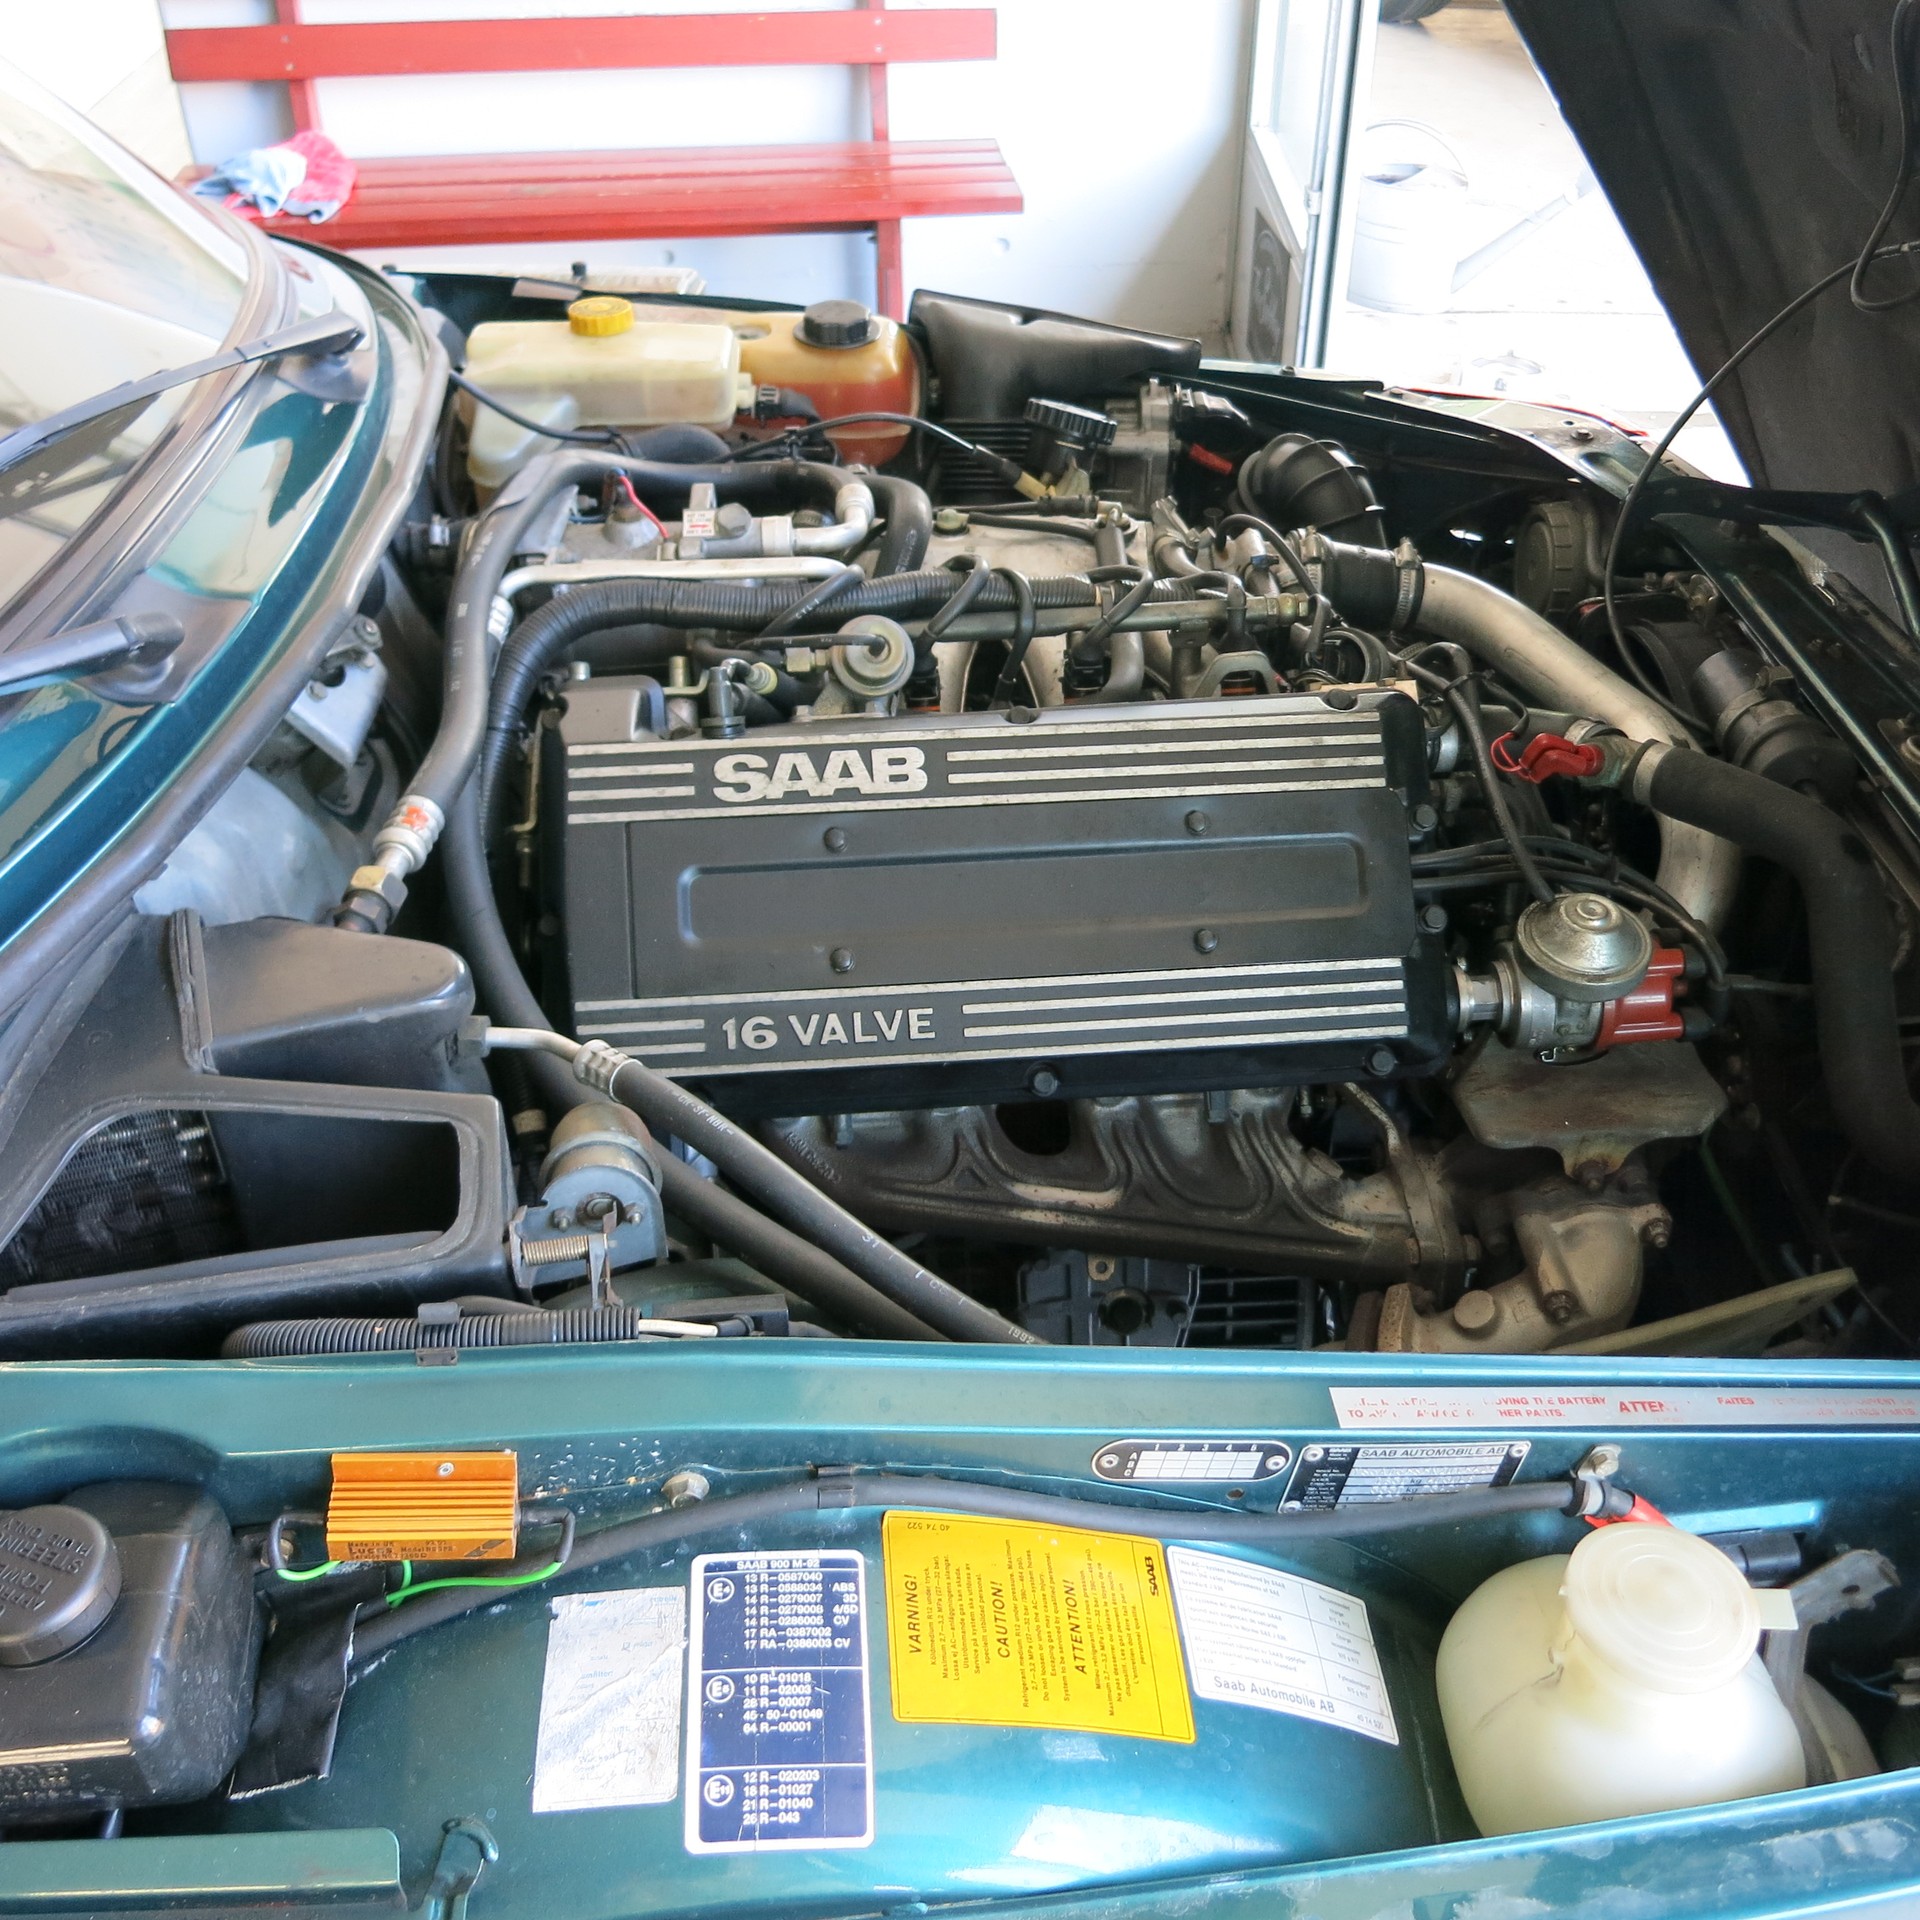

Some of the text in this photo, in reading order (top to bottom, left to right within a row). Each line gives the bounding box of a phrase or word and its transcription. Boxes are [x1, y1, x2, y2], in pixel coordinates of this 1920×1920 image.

[714, 747, 927, 802] SAAB
[722, 1008, 935, 1051] 16 VALVE
[1009, 1327, 1035, 1344] 1992
[1558, 1396, 1606, 1405] BATTERY
[1717, 1397, 1754, 1405] FAITES
[1348, 1410, 1364, 1418] TO
[1129, 1452, 1137, 1460] A
[1361, 1446, 1505, 1457] SAAB AUTOMOBILE AB
[737, 1559, 820, 1570] SAAB 900 M-92
[744, 1574, 757, 1583] 13
[1145, 1557, 1158, 1595] SAAB
[744, 1585, 757, 1594] 13
[832, 1582, 856, 1592] ABS
[744, 1595, 757, 1604] 14
[843, 1594, 858, 1602] 3D
[744, 1606, 757, 1616] 14
[832, 1604, 858, 1614] 4/5D
[905, 1574, 921, 1654] VARNING!
[744, 1618, 757, 1627] 14
[833, 1616, 849, 1625] CV
[991, 1581, 1010, 1658] CAUTION!
[1064, 1578, 1085, 1674] ATTENTION!
[744, 1629, 757, 1638] 17
[744, 1640, 757, 1650] 17
[834, 1637, 850, 1648] CV
[1055, 1626, 1064, 1654] serviced
[1136, 1632, 1146, 1665] personnel
[744, 1674, 758, 1684] 10
[744, 1686, 756, 1696] 11
[1020, 1668, 1028, 1707] Refrigerant
[1062, 1676, 1070, 1701] System
[1106, 1682, 1114, 1716] Maximum
[1214, 1676, 1335, 1713] Saab Automobile AB
[743, 1772, 758, 1783] 12
[743, 1799, 756, 1811] 21
